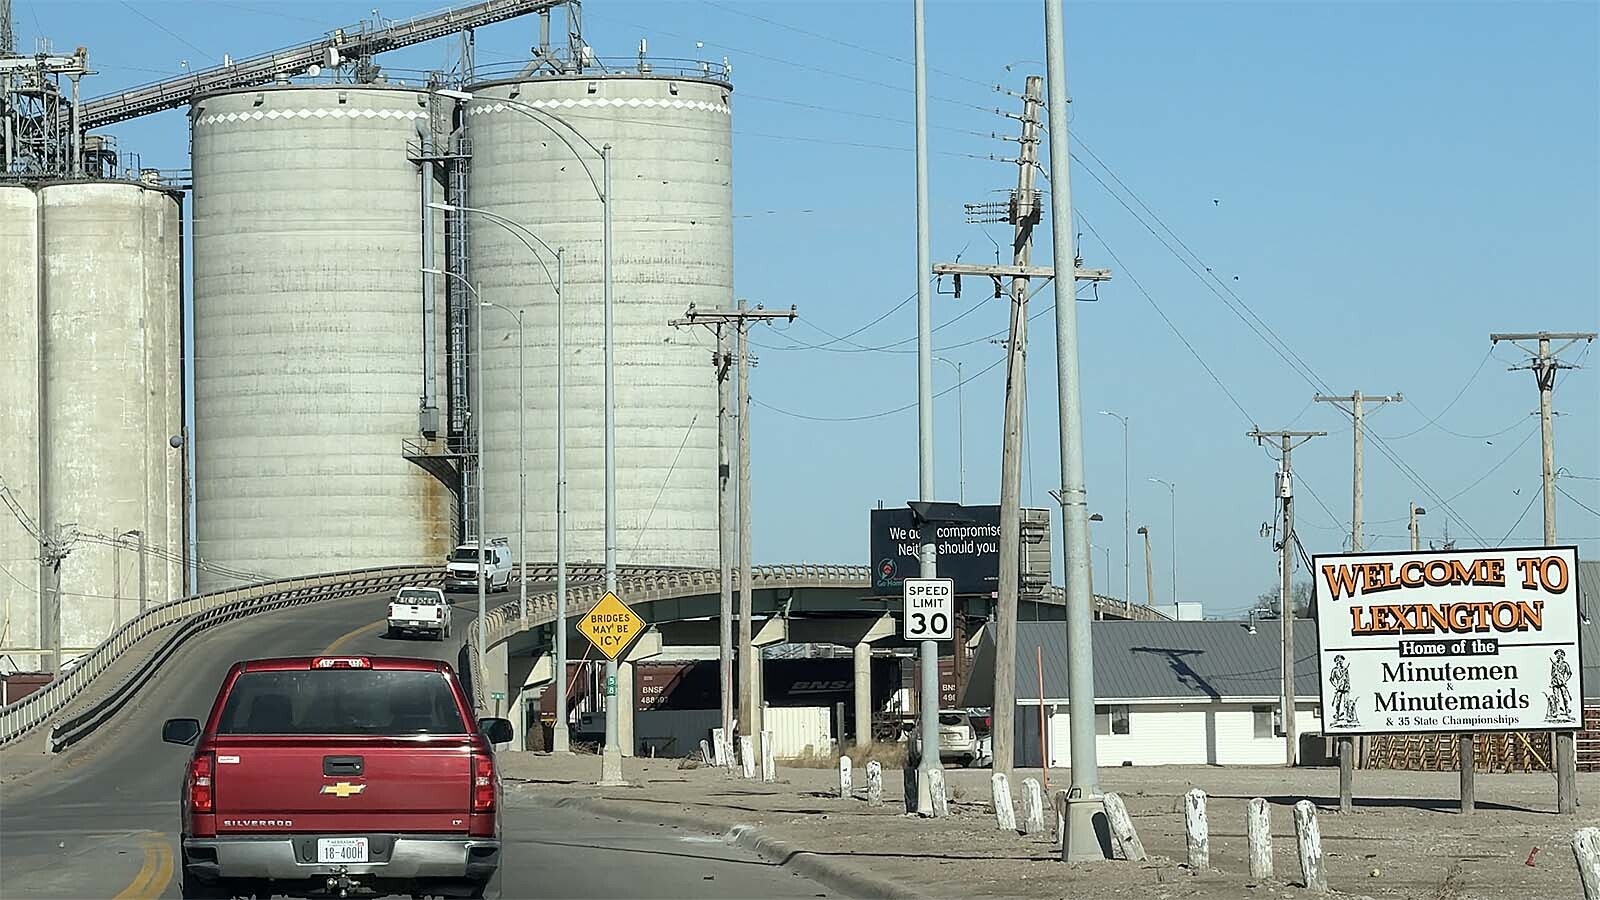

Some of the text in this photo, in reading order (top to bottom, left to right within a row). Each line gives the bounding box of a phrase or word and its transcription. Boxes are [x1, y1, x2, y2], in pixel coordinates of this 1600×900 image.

[889, 527, 907, 540] We
[938, 541, 974, 555] should
[977, 542, 999, 557] you.
[1322, 556, 1569, 601] WELCOME TO
[908, 586, 949, 596] SPEED
[913, 598, 944, 608] LIMIT
[591, 614, 630, 623] BRIDGES
[910, 613, 948, 634] 30
[1351, 601, 1544, 636] LEXINGTON
[593, 624, 628, 634] MAY BE
[600, 635, 621, 646] ICY
[1402, 640, 1496, 656] Home of the
[1382, 662, 1518, 683] Minutemen
[642, 686, 664, 694] BNSF
[1446, 682, 1454, 691] &
[1374, 688, 1530, 712] Minutemaids
[1386, 714, 1520, 728] & 35 State Championships
